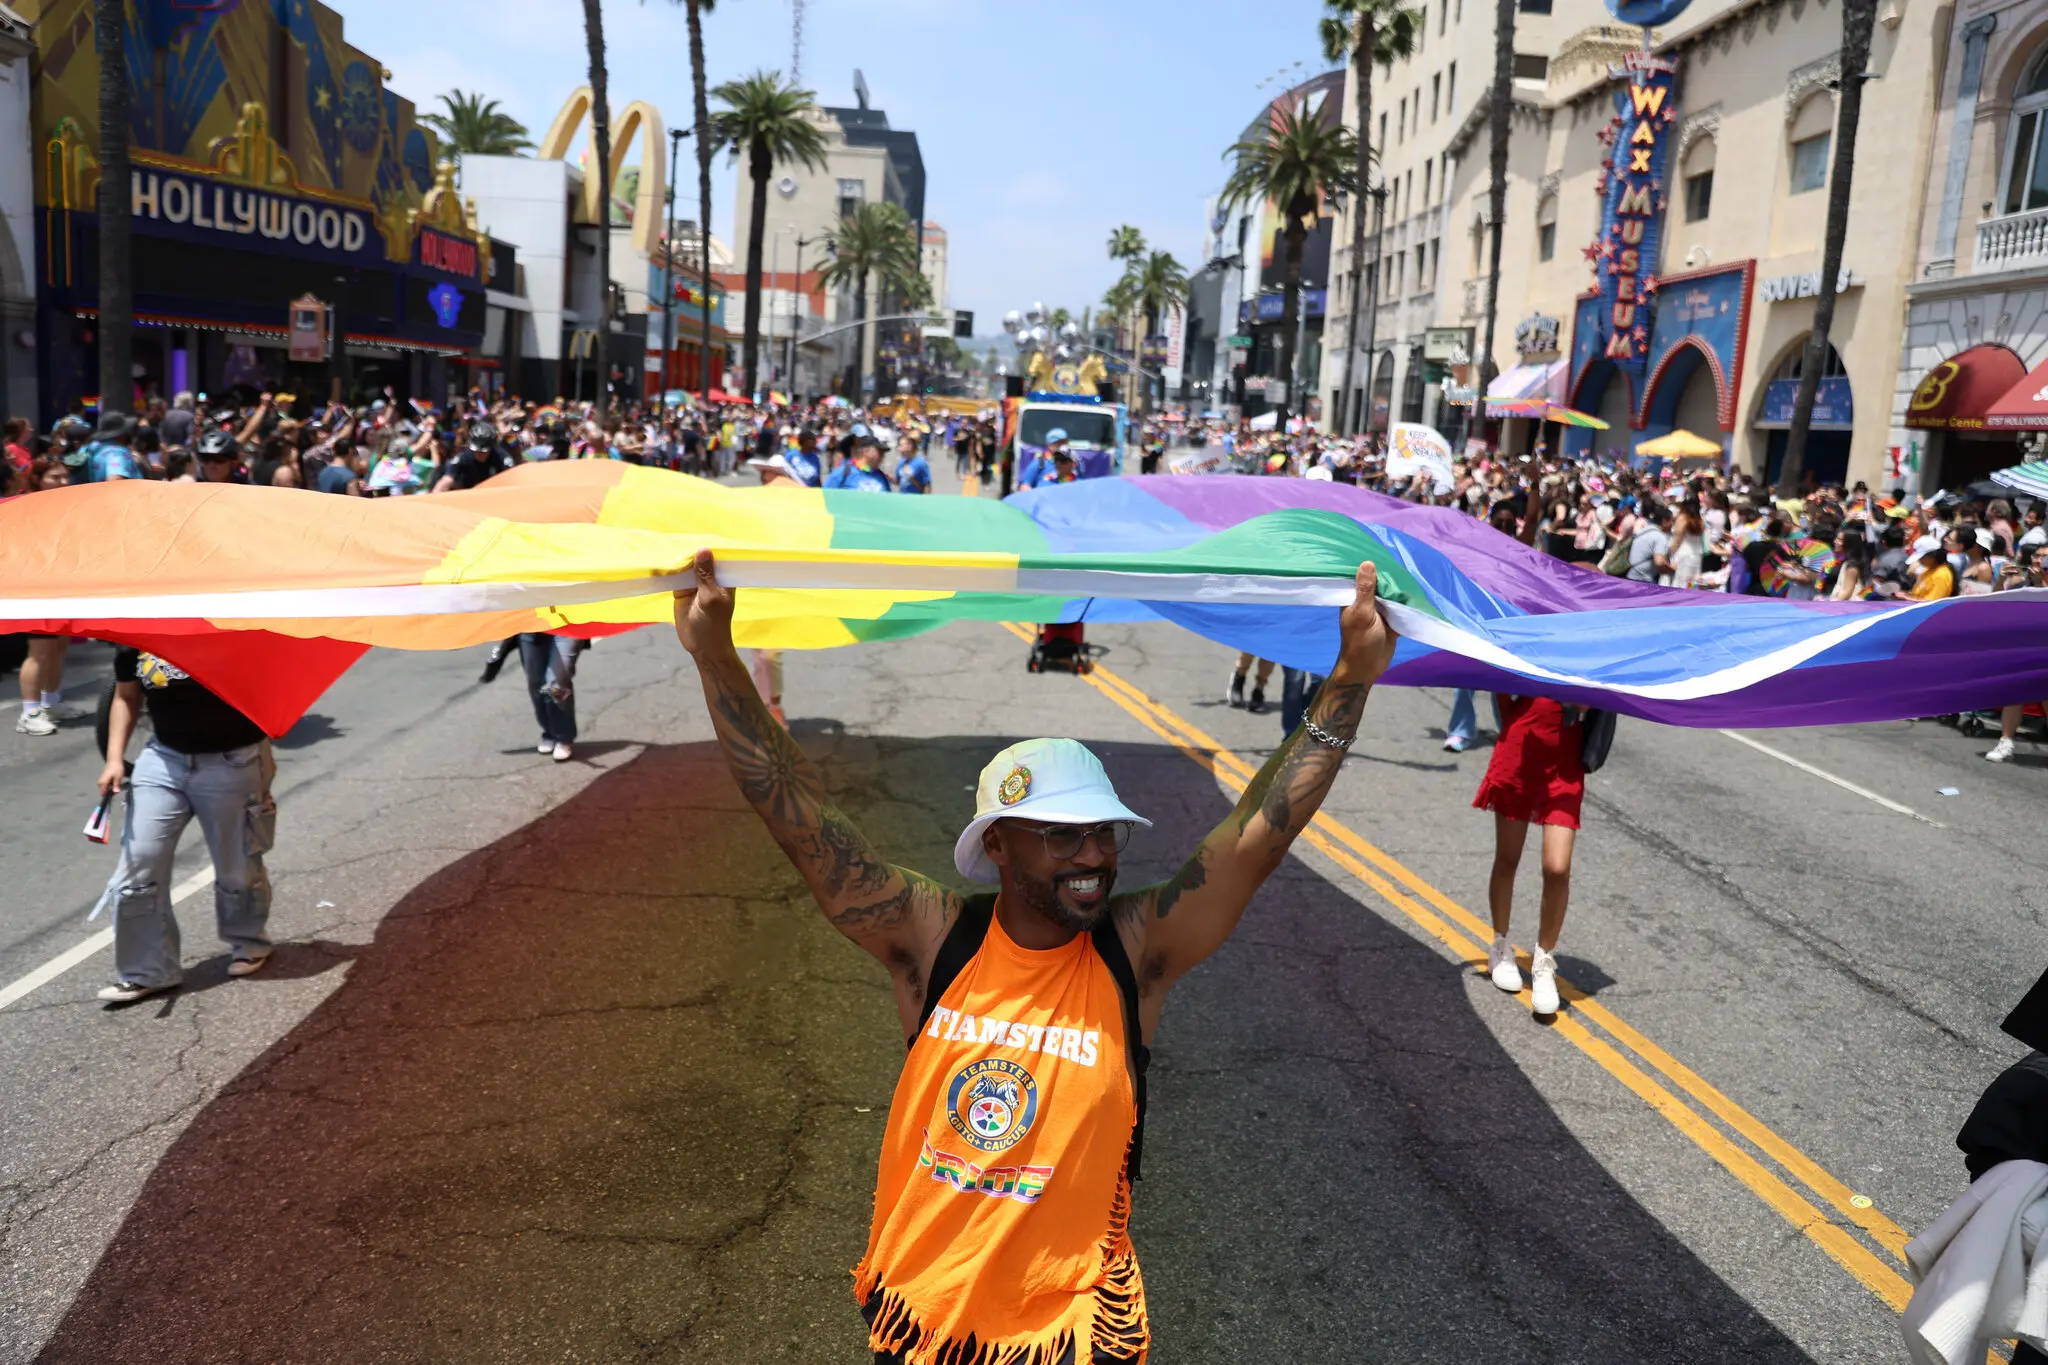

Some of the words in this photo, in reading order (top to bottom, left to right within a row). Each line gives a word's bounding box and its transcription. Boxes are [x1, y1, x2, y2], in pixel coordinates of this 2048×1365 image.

[1629, 84, 1667, 172] WAX
[132, 171, 366, 251] HOLLYWOOD
[1604, 180, 1653, 359] MUSEUM
[1759, 268, 1850, 301] SOUVENS
[1949, 416, 1984, 428] Cente
[2004, 415, 2048, 426] HOLLYWOO
[927, 1005, 1099, 1067] TAMSTERS
[960, 1060, 1035, 1091] TEAMSTERS
[948, 1110, 981, 1147] LGBTQ+
[984, 1124, 1027, 1151] CAUCUS
